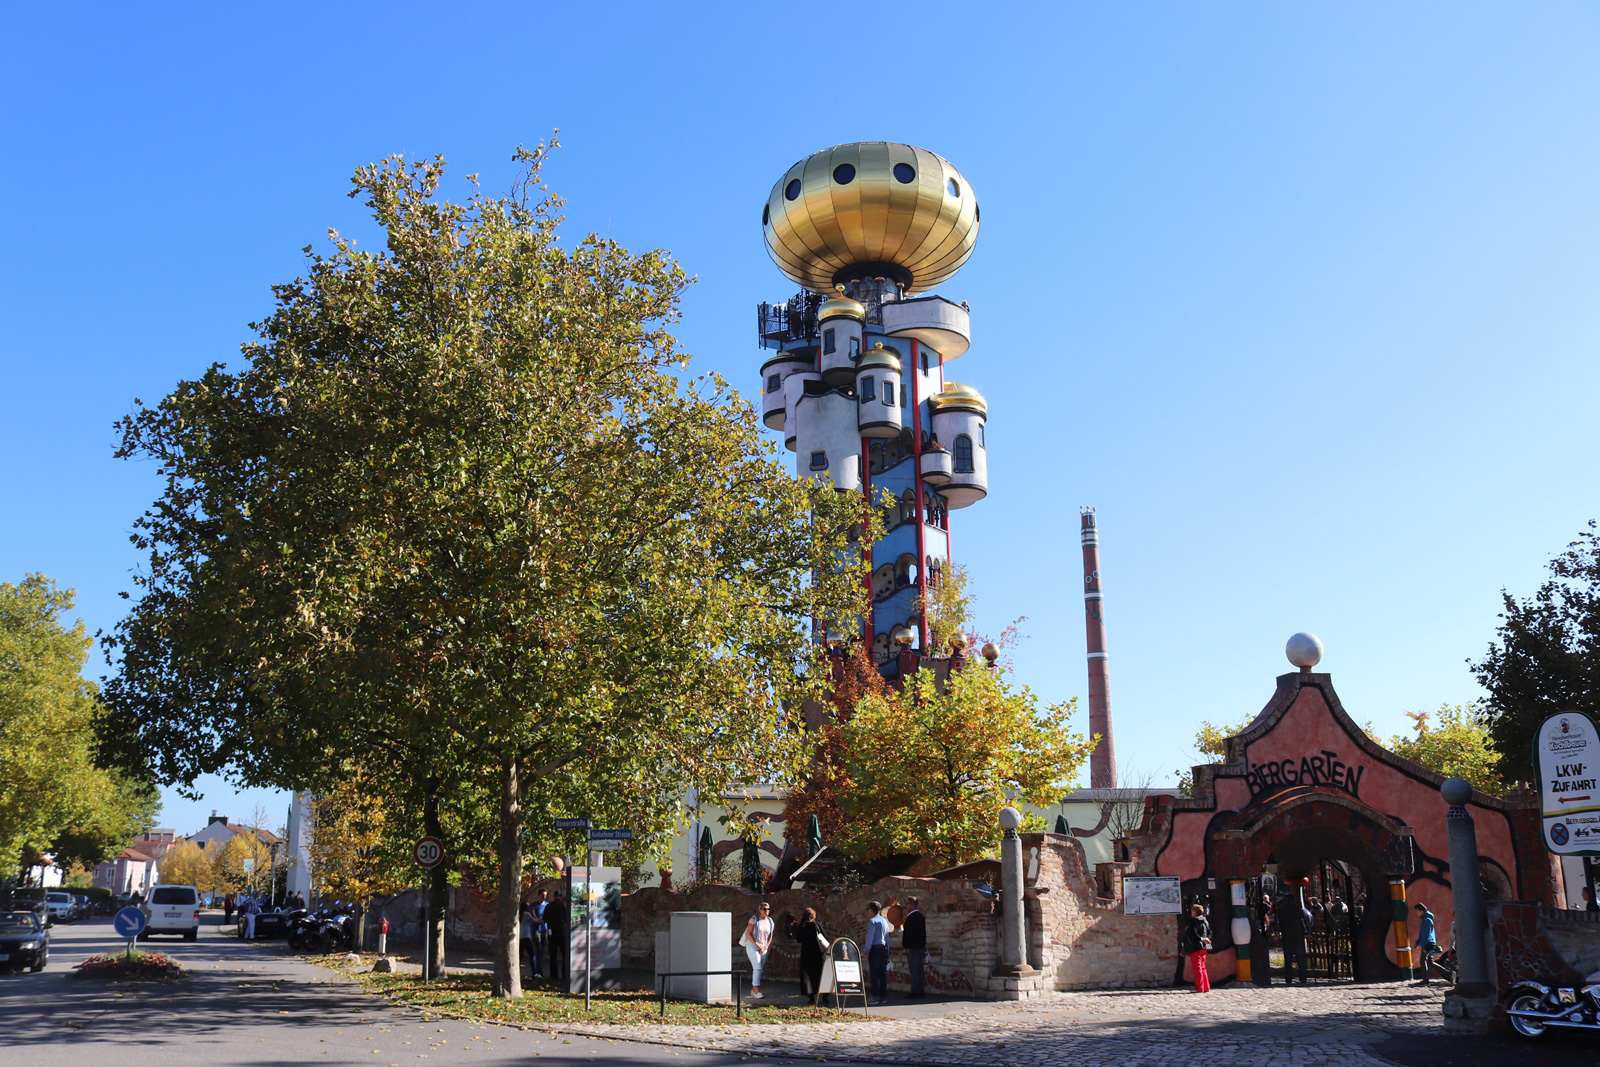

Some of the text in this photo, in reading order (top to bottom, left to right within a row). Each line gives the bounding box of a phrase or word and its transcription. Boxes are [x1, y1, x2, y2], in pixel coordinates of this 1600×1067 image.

[1556, 763, 1587, 777] LKW-
[1551, 779, 1597, 792] ZUFAHRT
[420, 845, 437, 859] 30
